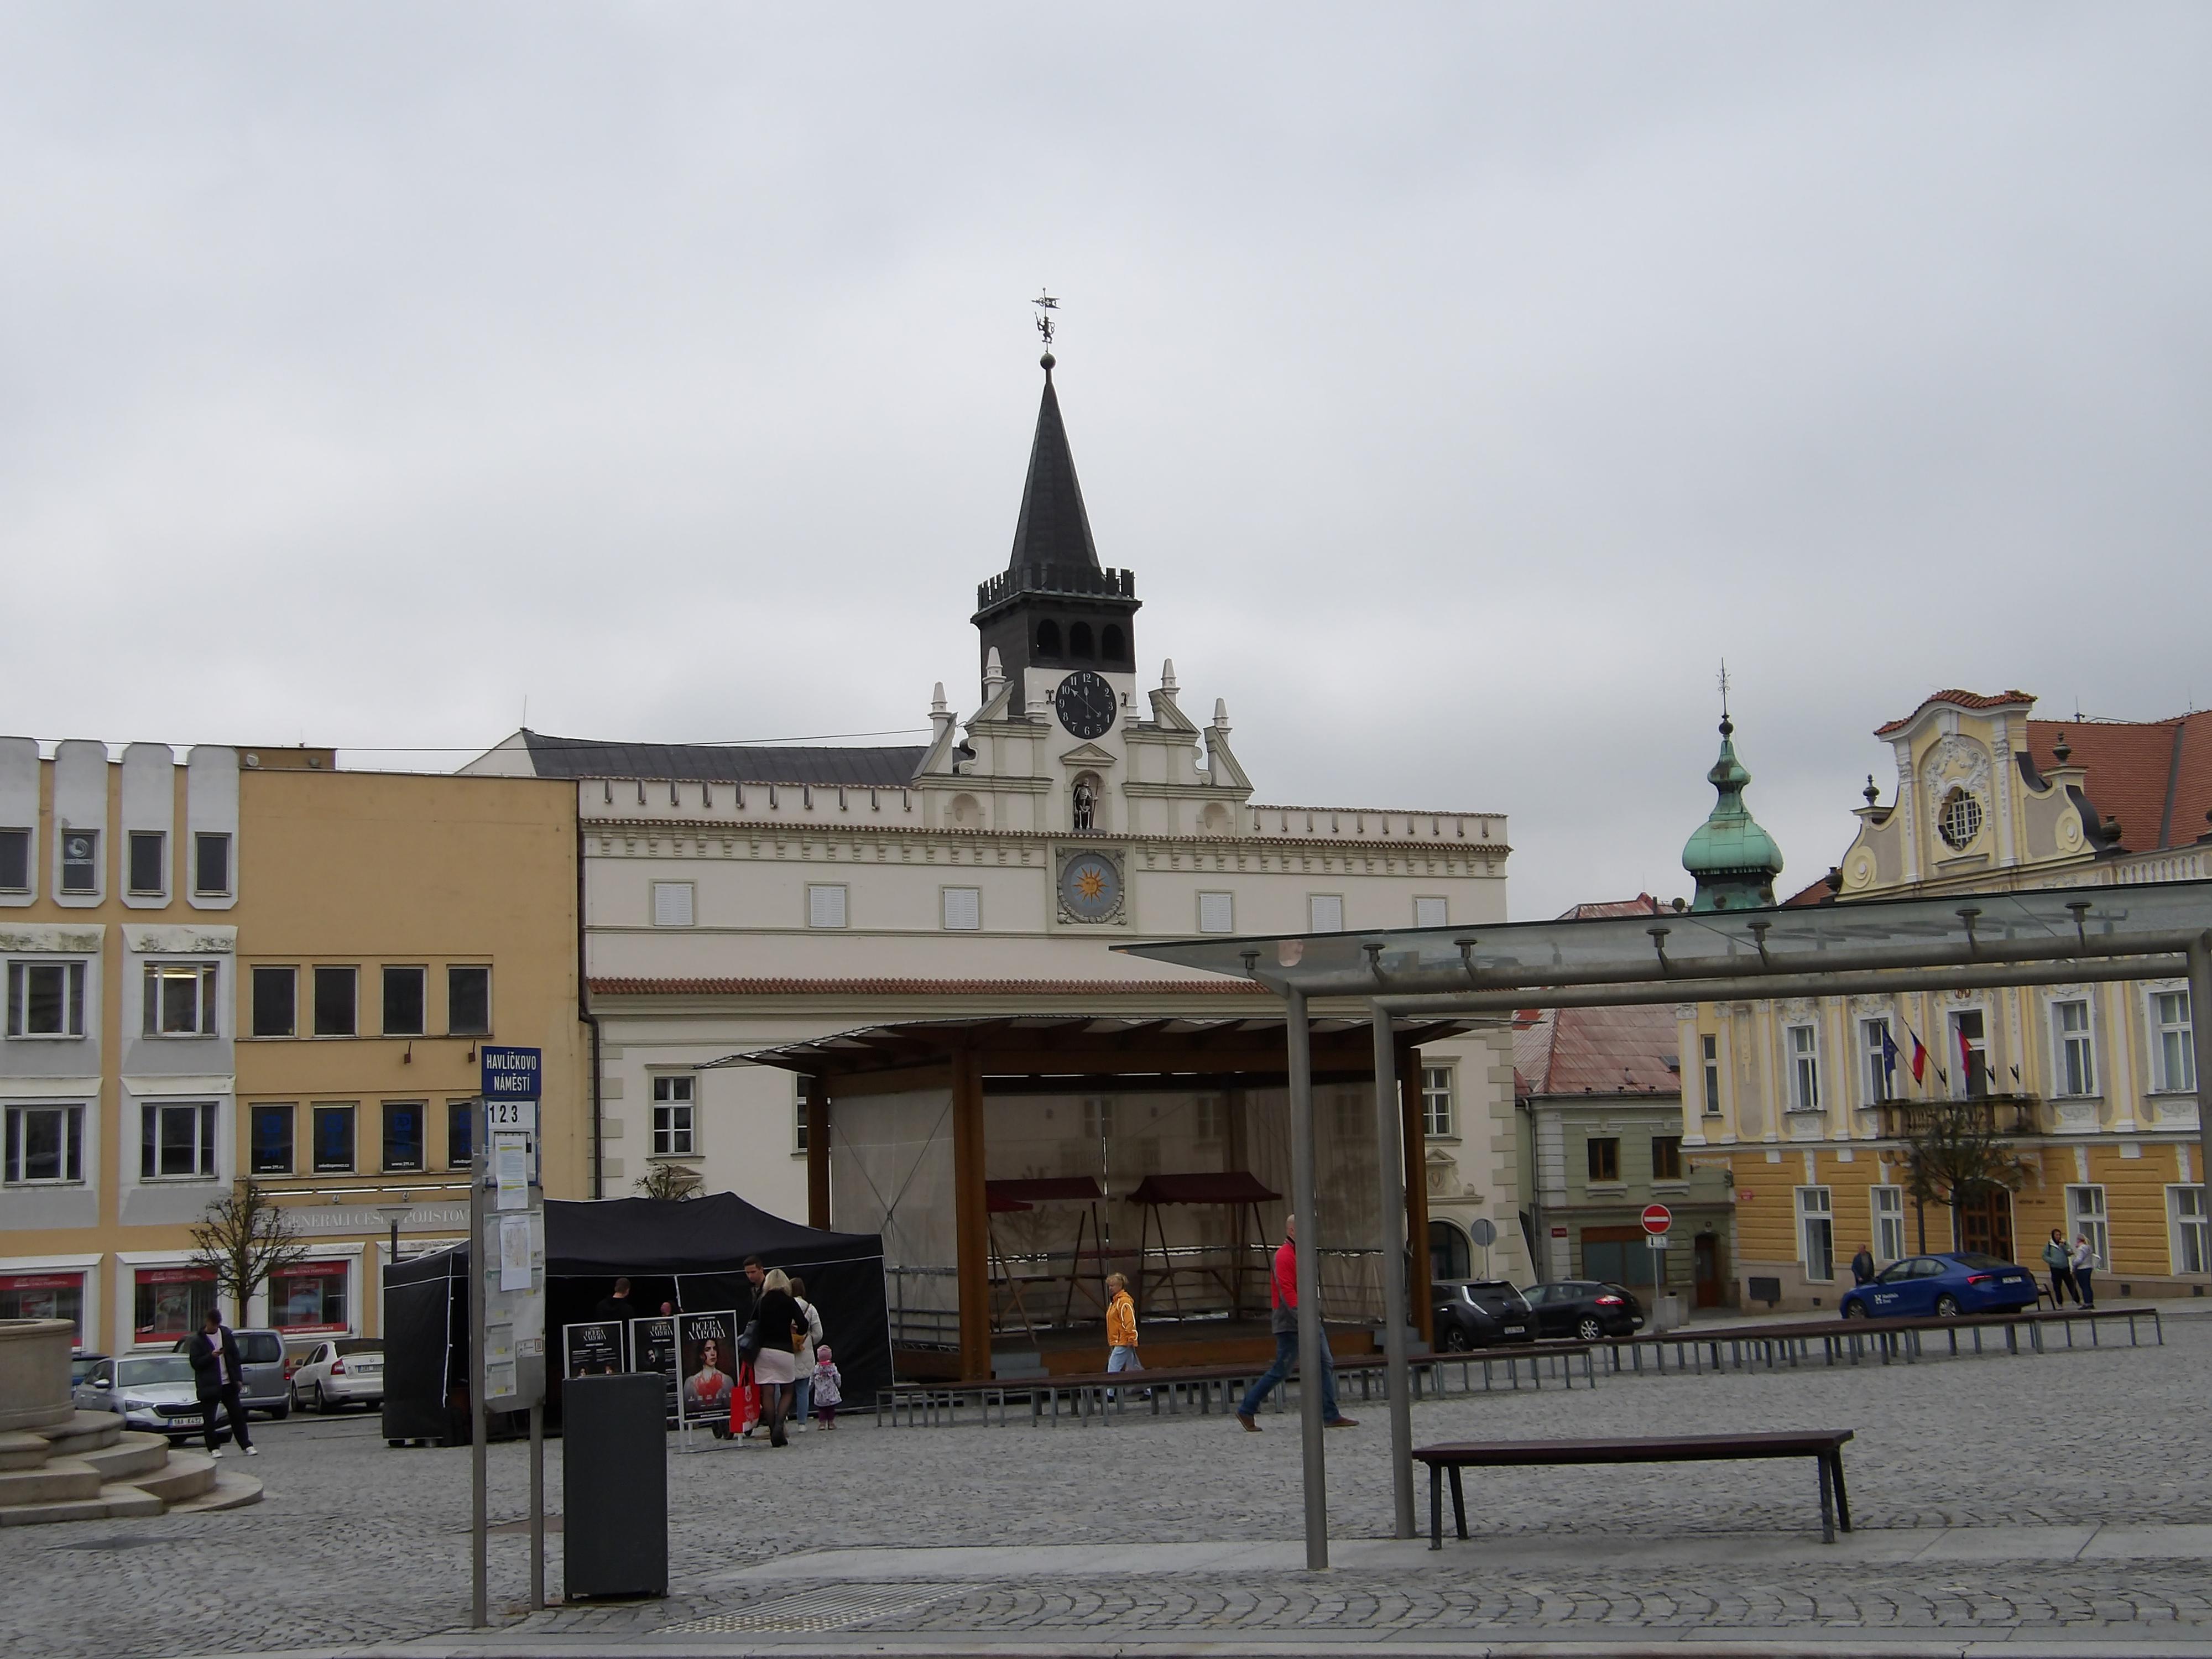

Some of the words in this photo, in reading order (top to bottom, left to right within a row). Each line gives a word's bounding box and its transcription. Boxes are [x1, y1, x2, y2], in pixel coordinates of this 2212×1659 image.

[1071, 676, 1077, 686] 11
[1083, 673, 1092, 683] 12
[1097, 677, 1100, 687] 1
[1062, 685, 1070, 695] 10
[1104, 687, 1110, 697] 2
[1059, 698, 1065, 708] 9
[1108, 701, 1114, 711] 3
[1063, 712, 1068, 721] 8
[1072, 721, 1078, 732] 7
[1084, 726, 1090, 735] 6
[1097, 724, 1102, 733] 5
[487, 1051, 536, 1070] HAVLÍČKOVO
[494, 1073, 530, 1091] NÁMĚSTÍ
[281, 1213, 350, 1228] GENERALI
[692, 1320, 721, 1331] DCERA
